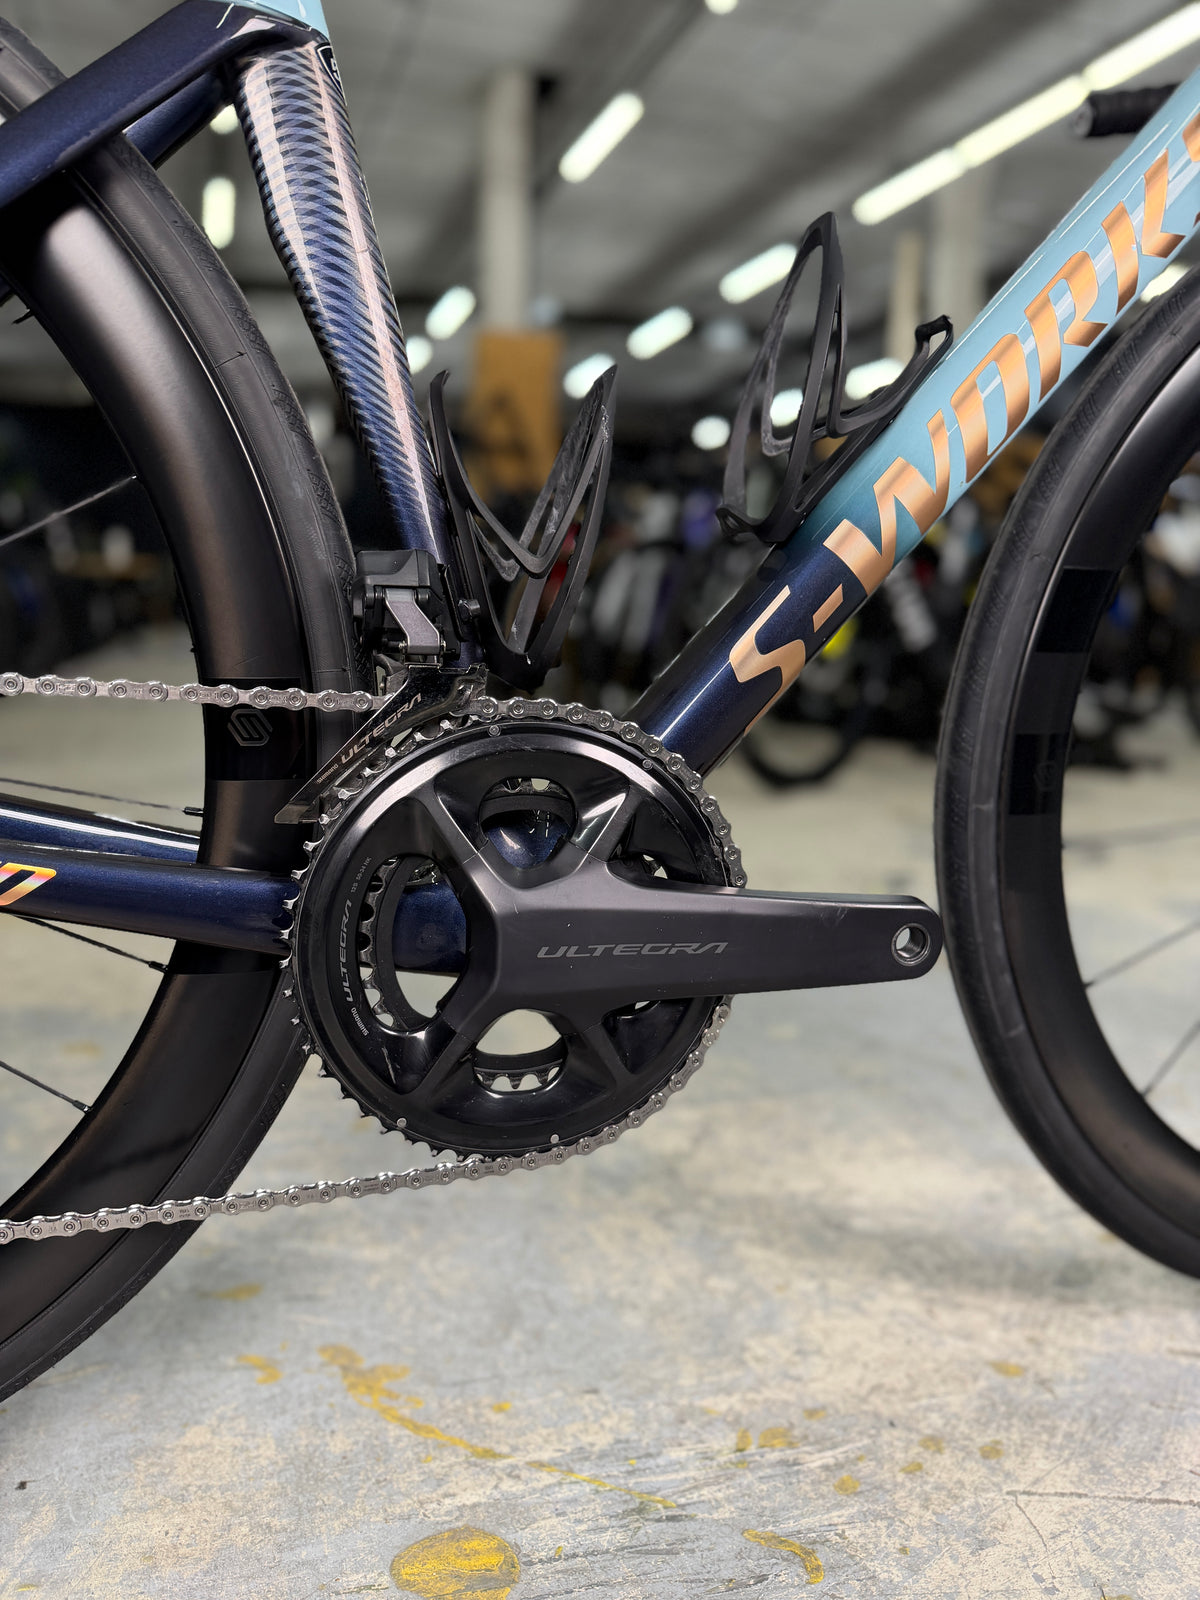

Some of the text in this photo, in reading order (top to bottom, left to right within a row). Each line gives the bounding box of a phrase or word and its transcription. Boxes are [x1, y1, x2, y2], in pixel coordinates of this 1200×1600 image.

[315, 693, 422, 785] SHIMANO ULTEGRA
[339, 899, 353, 1003] ULTEGRA
[537, 942, 729, 959] ULTEGRA
[350, 1006, 370, 1037] SHIMANO
